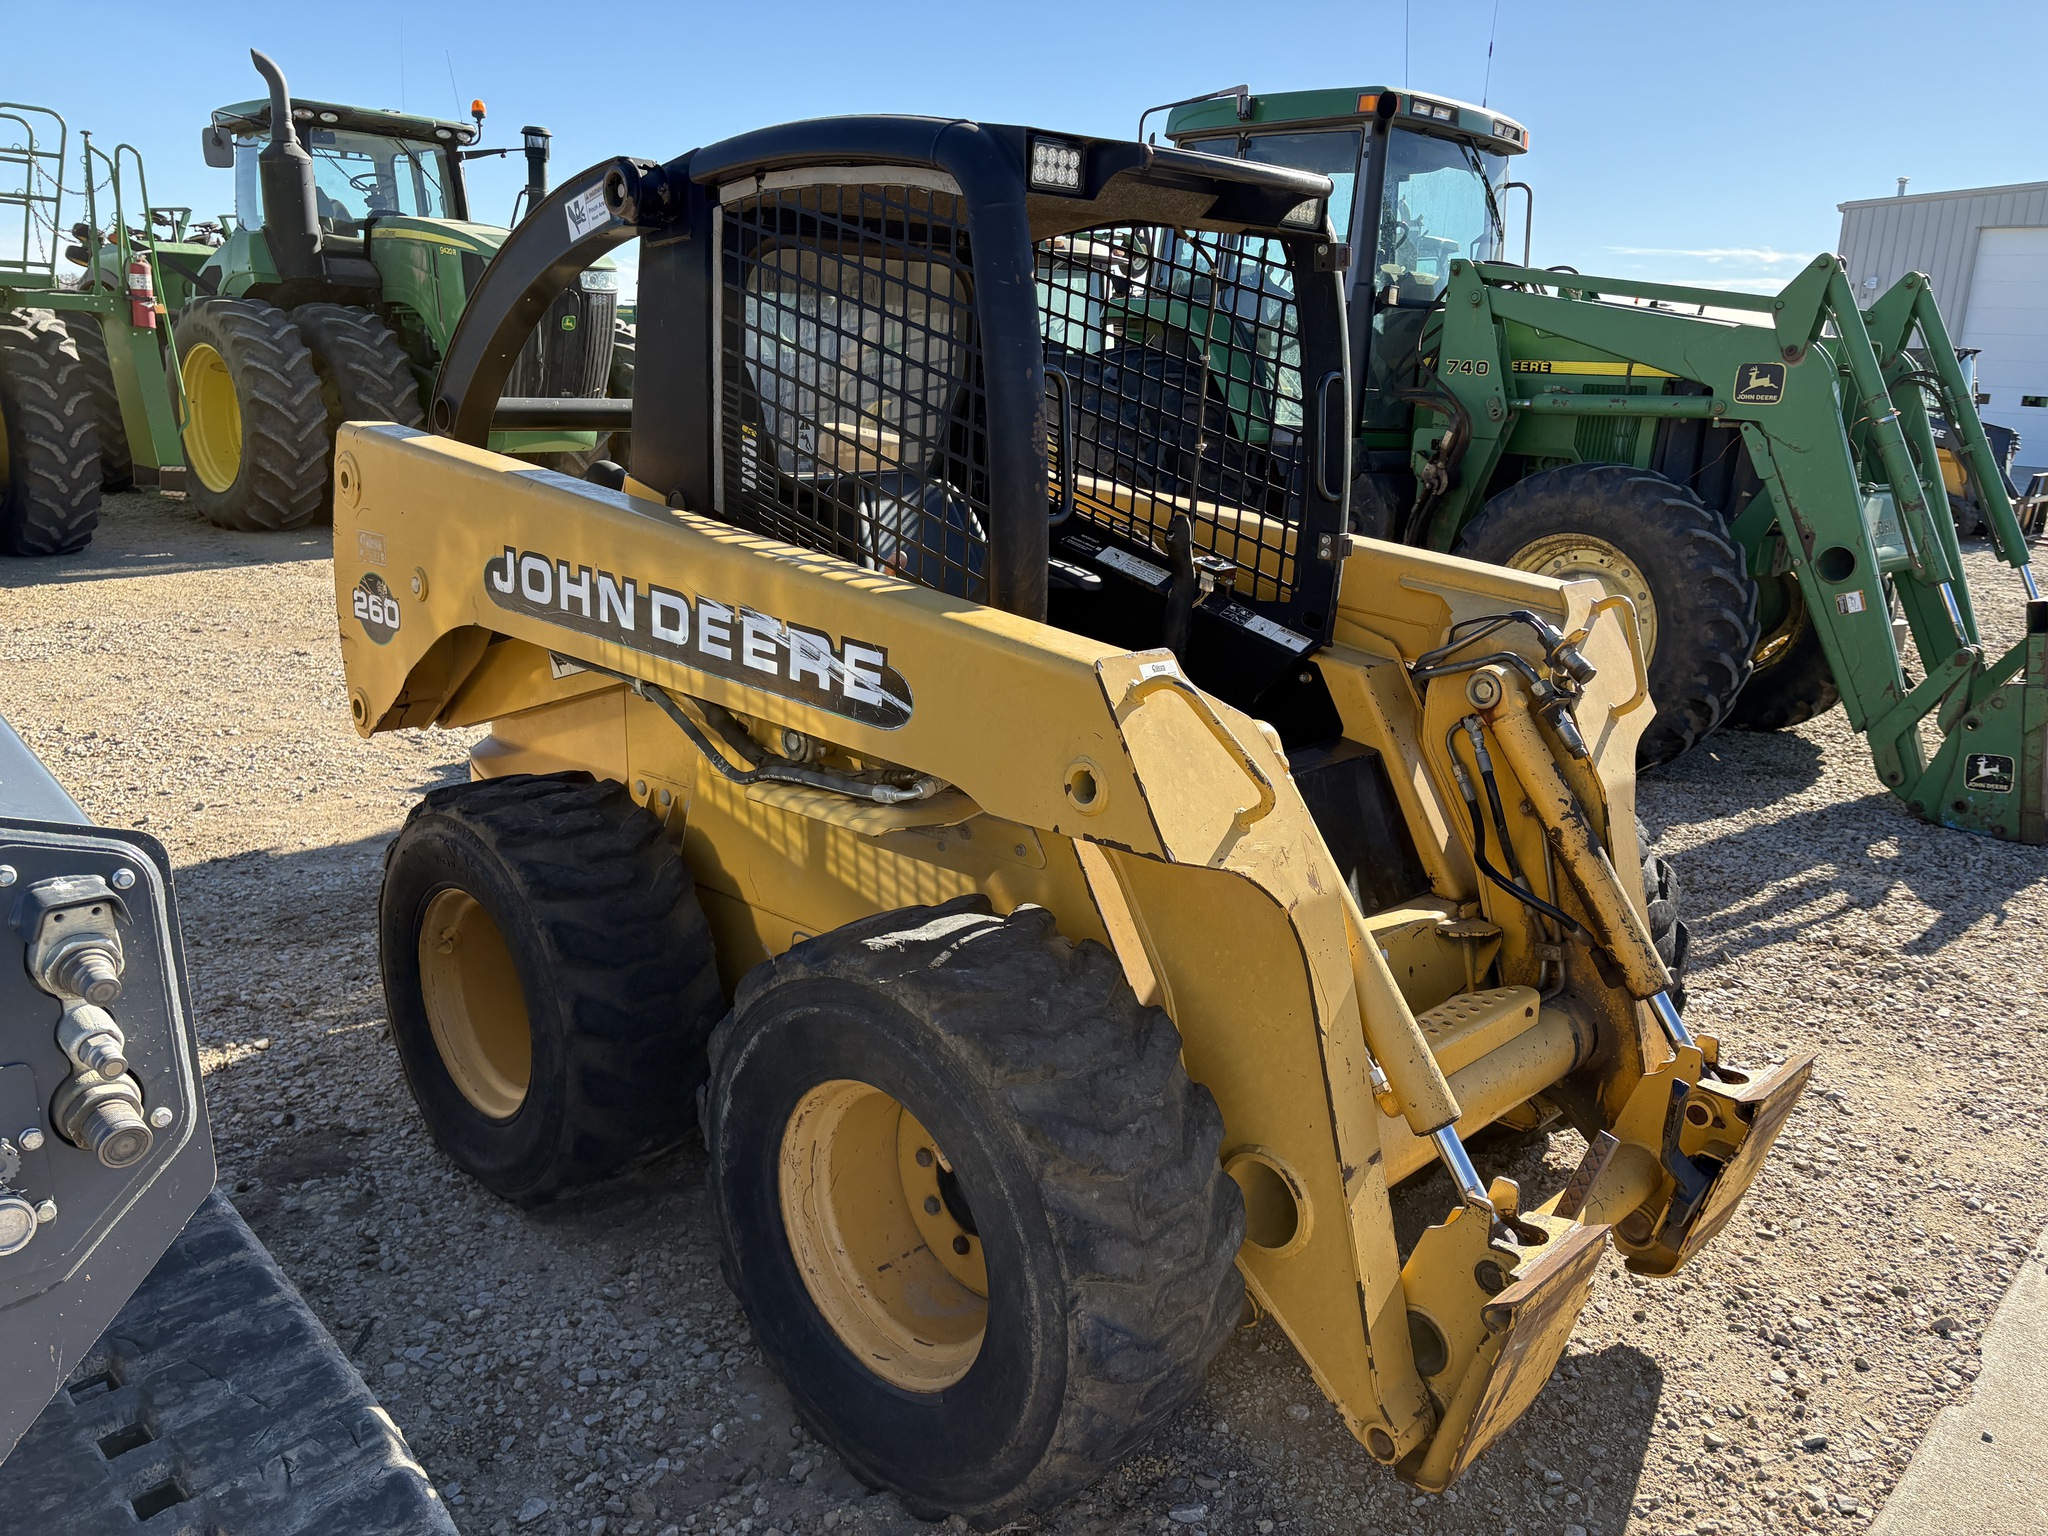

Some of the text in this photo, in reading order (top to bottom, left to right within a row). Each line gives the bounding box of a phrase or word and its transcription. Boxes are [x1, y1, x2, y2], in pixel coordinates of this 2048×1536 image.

[1446, 359, 1490, 377] 740
[1511, 361, 1550, 373] EERE
[1930, 427, 1947, 439] RE
[1143, 562, 1164, 573] CAUTION
[353, 589, 400, 630] 260
[491, 551, 884, 708] JOHN DEERE
[1286, 630, 1311, 644] WARNING
